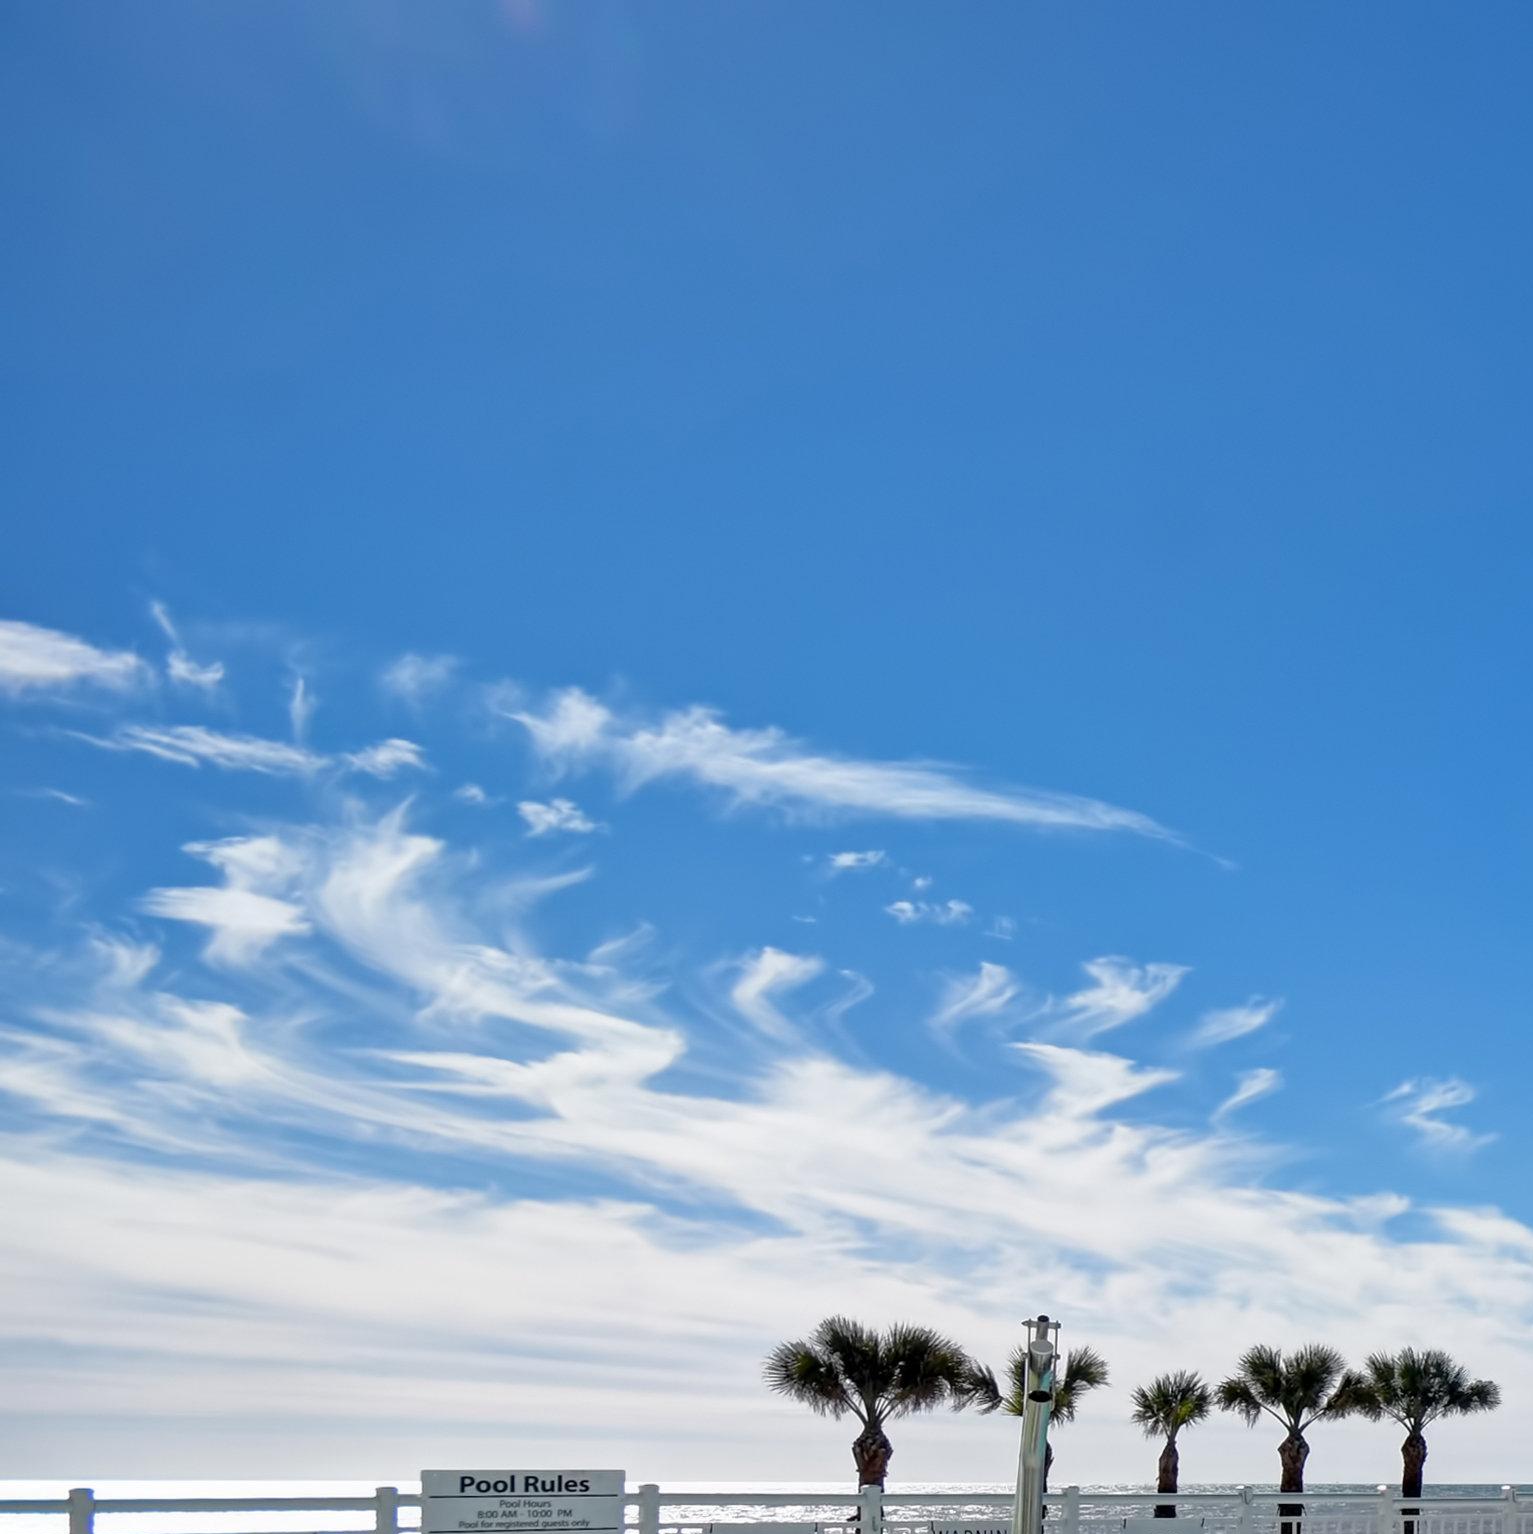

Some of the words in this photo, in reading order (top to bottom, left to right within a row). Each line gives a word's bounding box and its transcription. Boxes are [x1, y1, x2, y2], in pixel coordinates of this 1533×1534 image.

[460, 1475, 515, 1493] Pool
[524, 1475, 590, 1493] Rules
[500, 1500, 521, 1508] Pool
[523, 1500, 552, 1508] Hours
[477, 1510, 498, 1519] 8:00
[501, 1510, 517, 1518] AM
[527, 1509, 552, 1518] 10:00
[558, 1509, 573, 1517] PM
[458, 1521, 479, 1529] Pool
[481, 1520, 493, 1528] for
[495, 1519, 539, 1530] registered
[541, 1520, 569, 1529] guests
[571, 1519, 590, 1529] only
